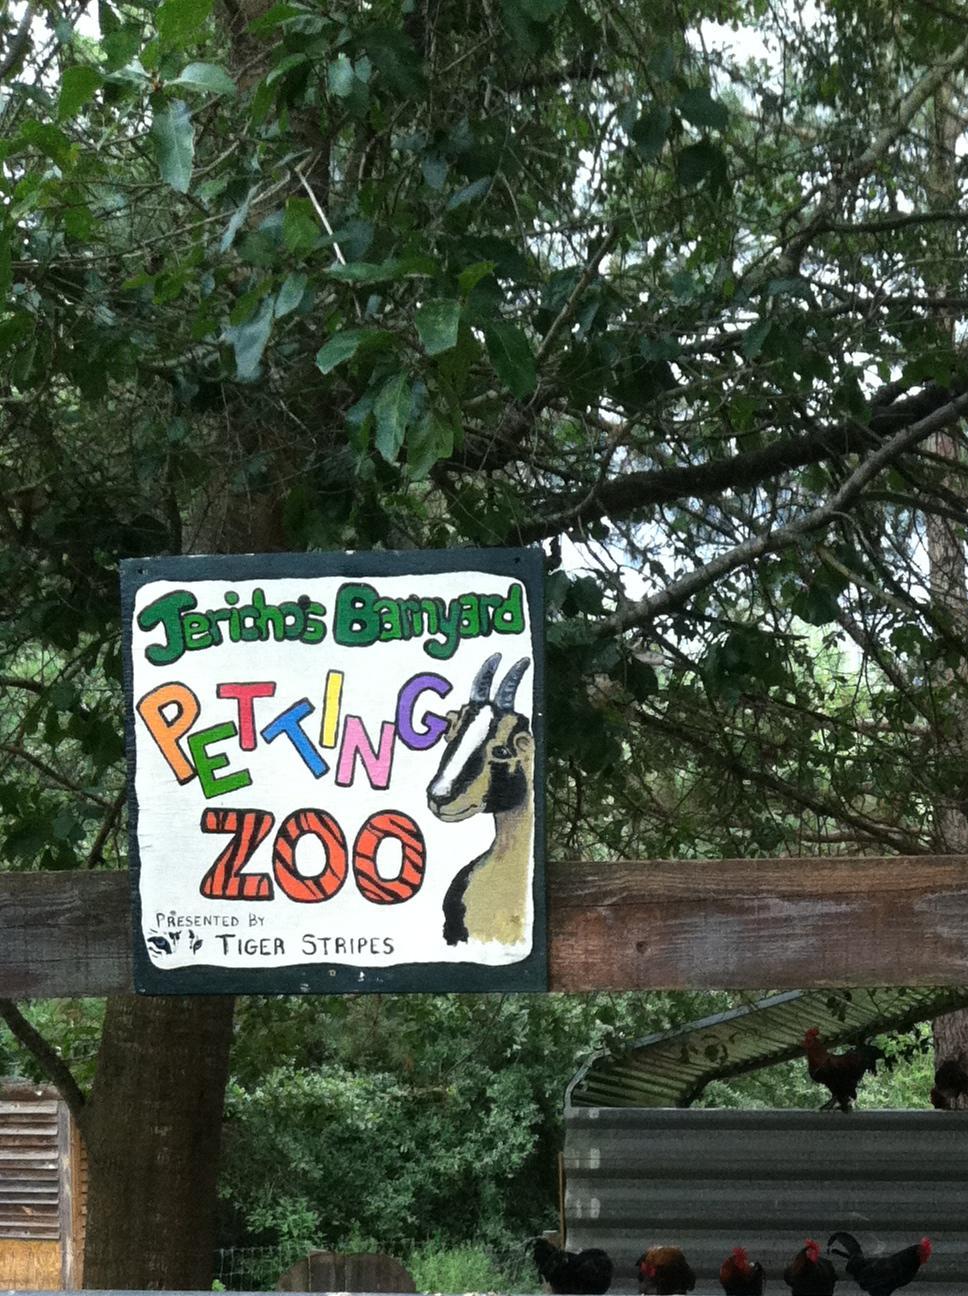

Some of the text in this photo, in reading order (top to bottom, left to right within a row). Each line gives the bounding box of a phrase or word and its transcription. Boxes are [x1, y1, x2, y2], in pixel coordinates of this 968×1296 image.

[333, 582, 526, 661] Barnyard
[135, 669, 454, 799] PETTING
[200, 807, 427, 905] ZOO
[156, 911, 240, 928] PRESENTED
[215, 933, 395, 956] TIGER STRIPES
